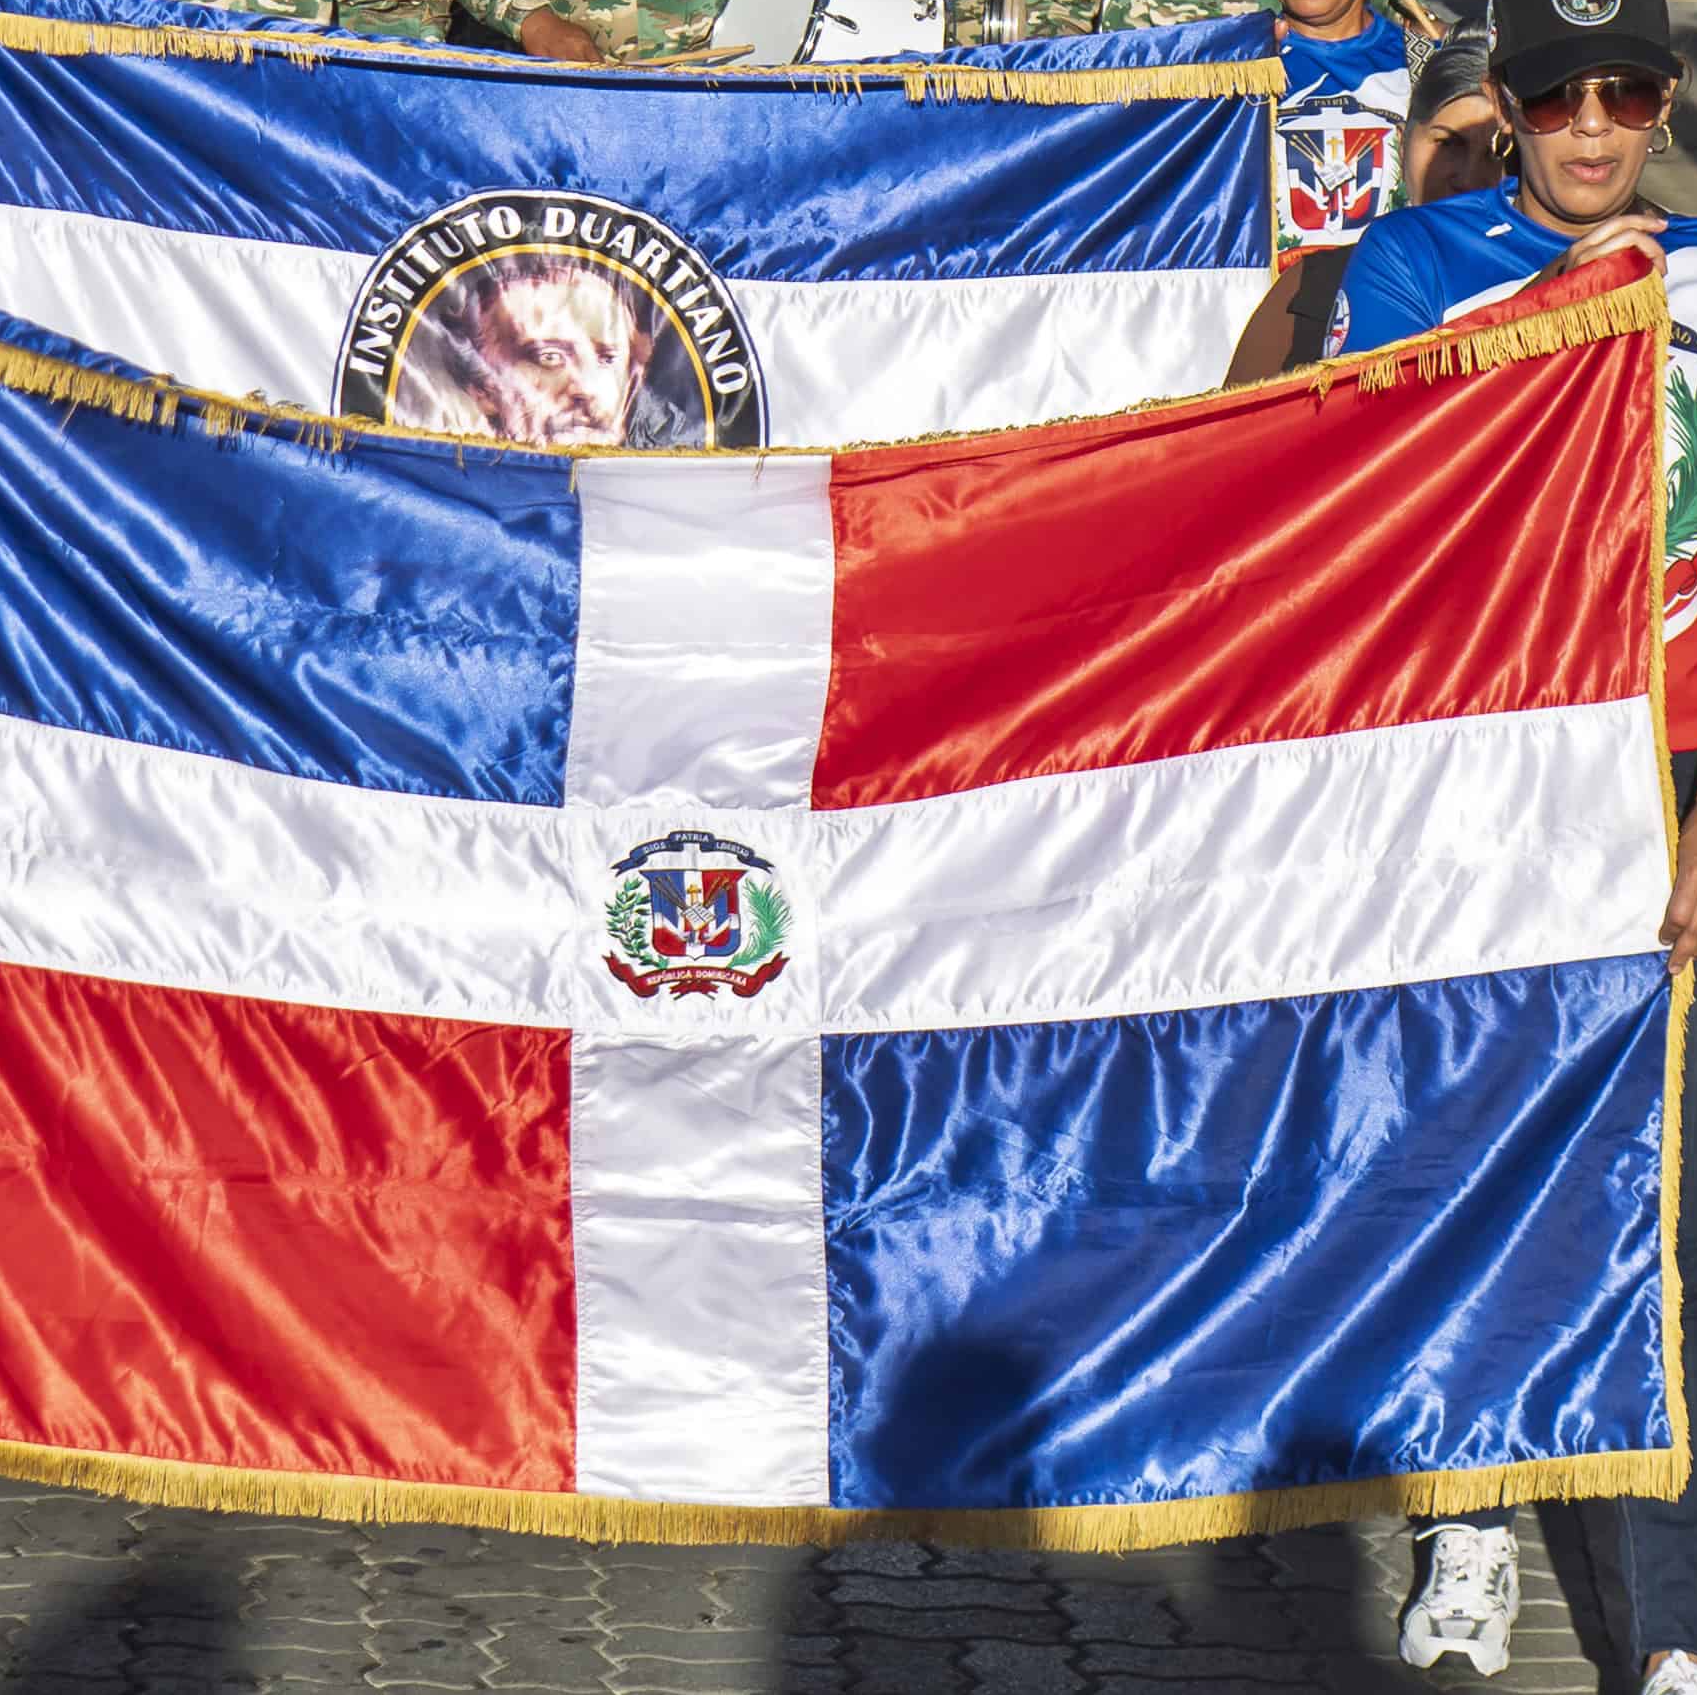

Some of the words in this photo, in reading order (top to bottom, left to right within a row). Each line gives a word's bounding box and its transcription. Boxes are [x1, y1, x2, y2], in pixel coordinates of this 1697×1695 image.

[348, 204, 524, 378] INSTITUTO
[543, 205, 749, 396] DUARTIANO
[675, 832, 710, 843] PATRIA
